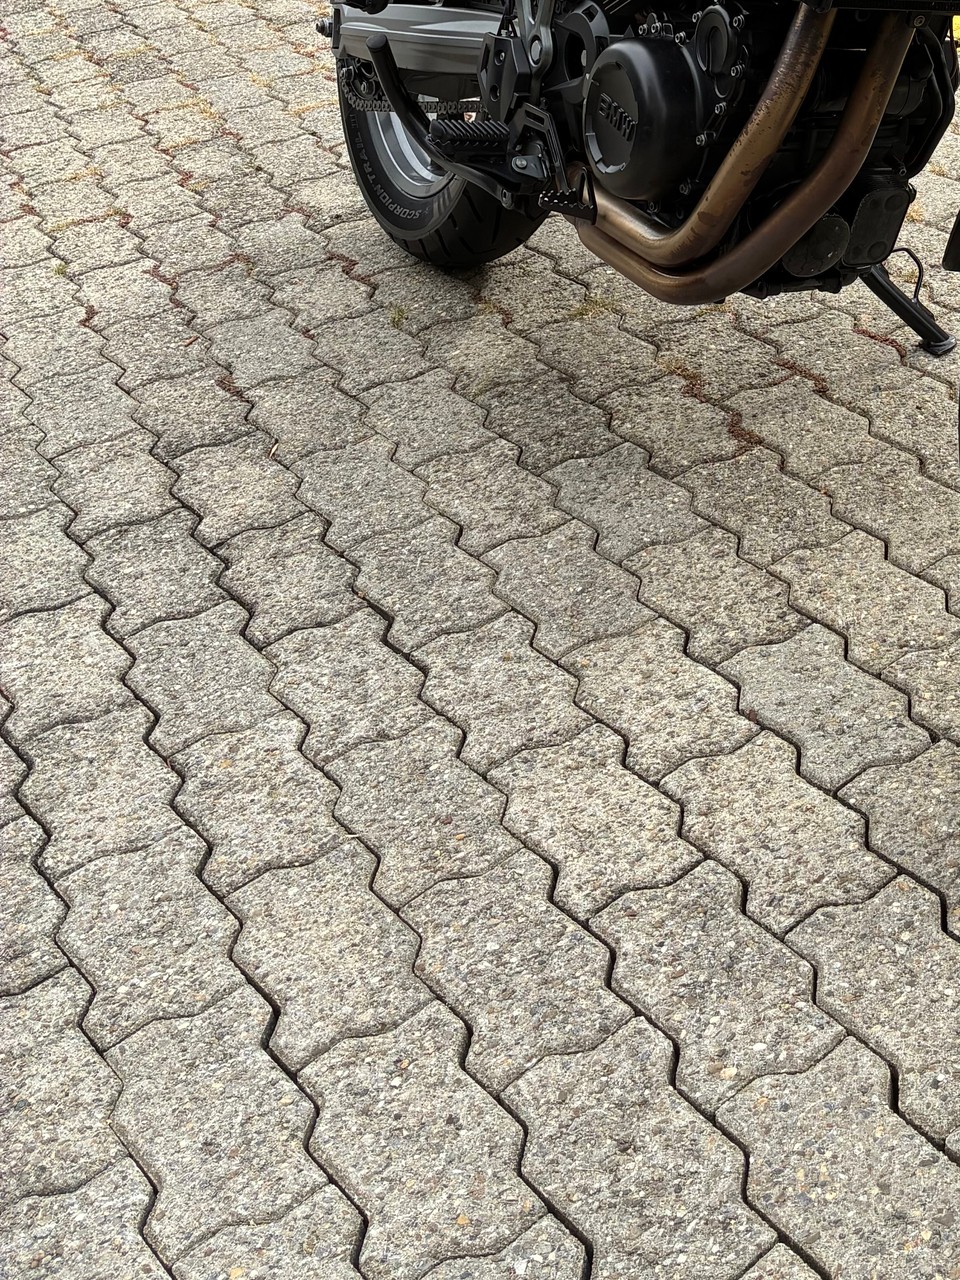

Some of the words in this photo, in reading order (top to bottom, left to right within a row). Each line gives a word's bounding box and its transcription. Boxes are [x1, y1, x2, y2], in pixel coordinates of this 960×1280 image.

[598, 91, 638, 142] BMW
[355, 131, 376, 183] TRAIL
[373, 184, 422, 219] SCORPION
